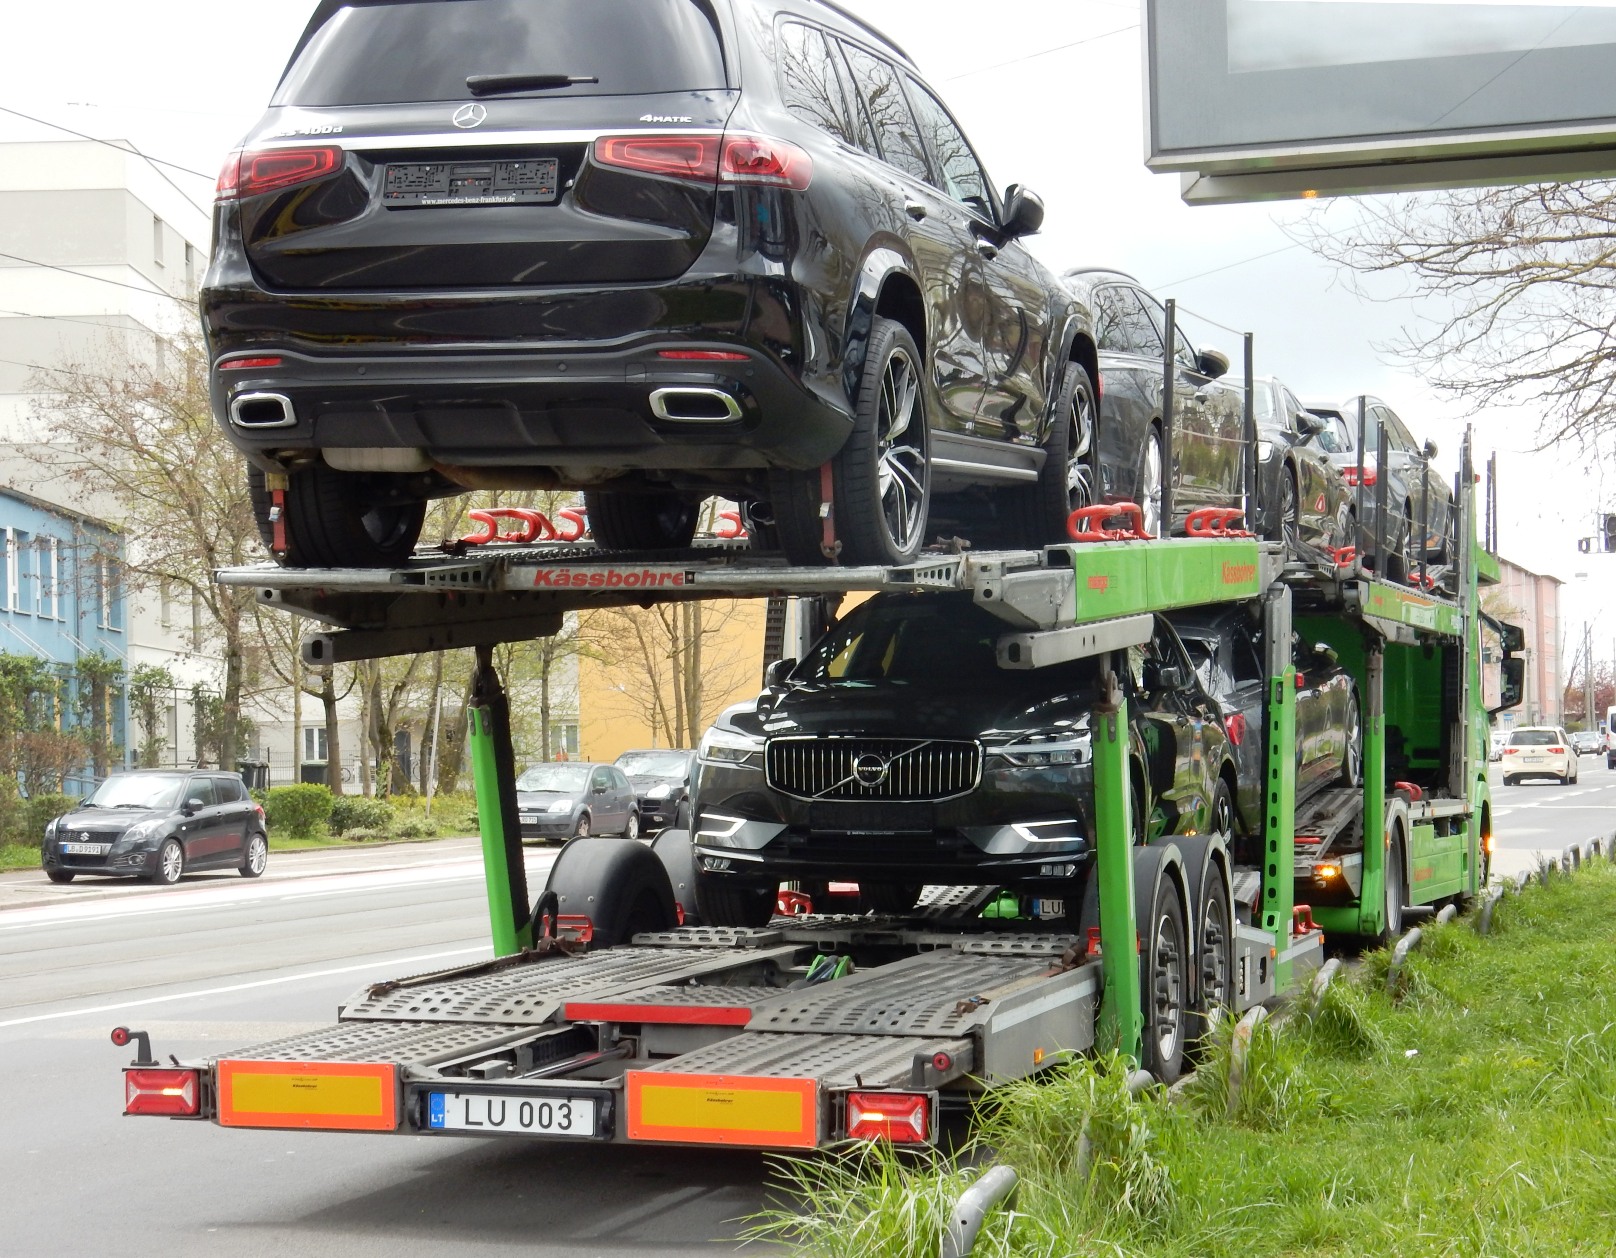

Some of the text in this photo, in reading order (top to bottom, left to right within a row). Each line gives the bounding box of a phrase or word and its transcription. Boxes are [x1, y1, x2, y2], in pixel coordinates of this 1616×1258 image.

[639, 113, 693, 124] 4MATIC
[421, 195, 516, 205] www.mercedes-benz-frankfurt.de
[533, 568, 686, 588] Kässbohre
[431, 1098, 573, 1131] LT LU 003
